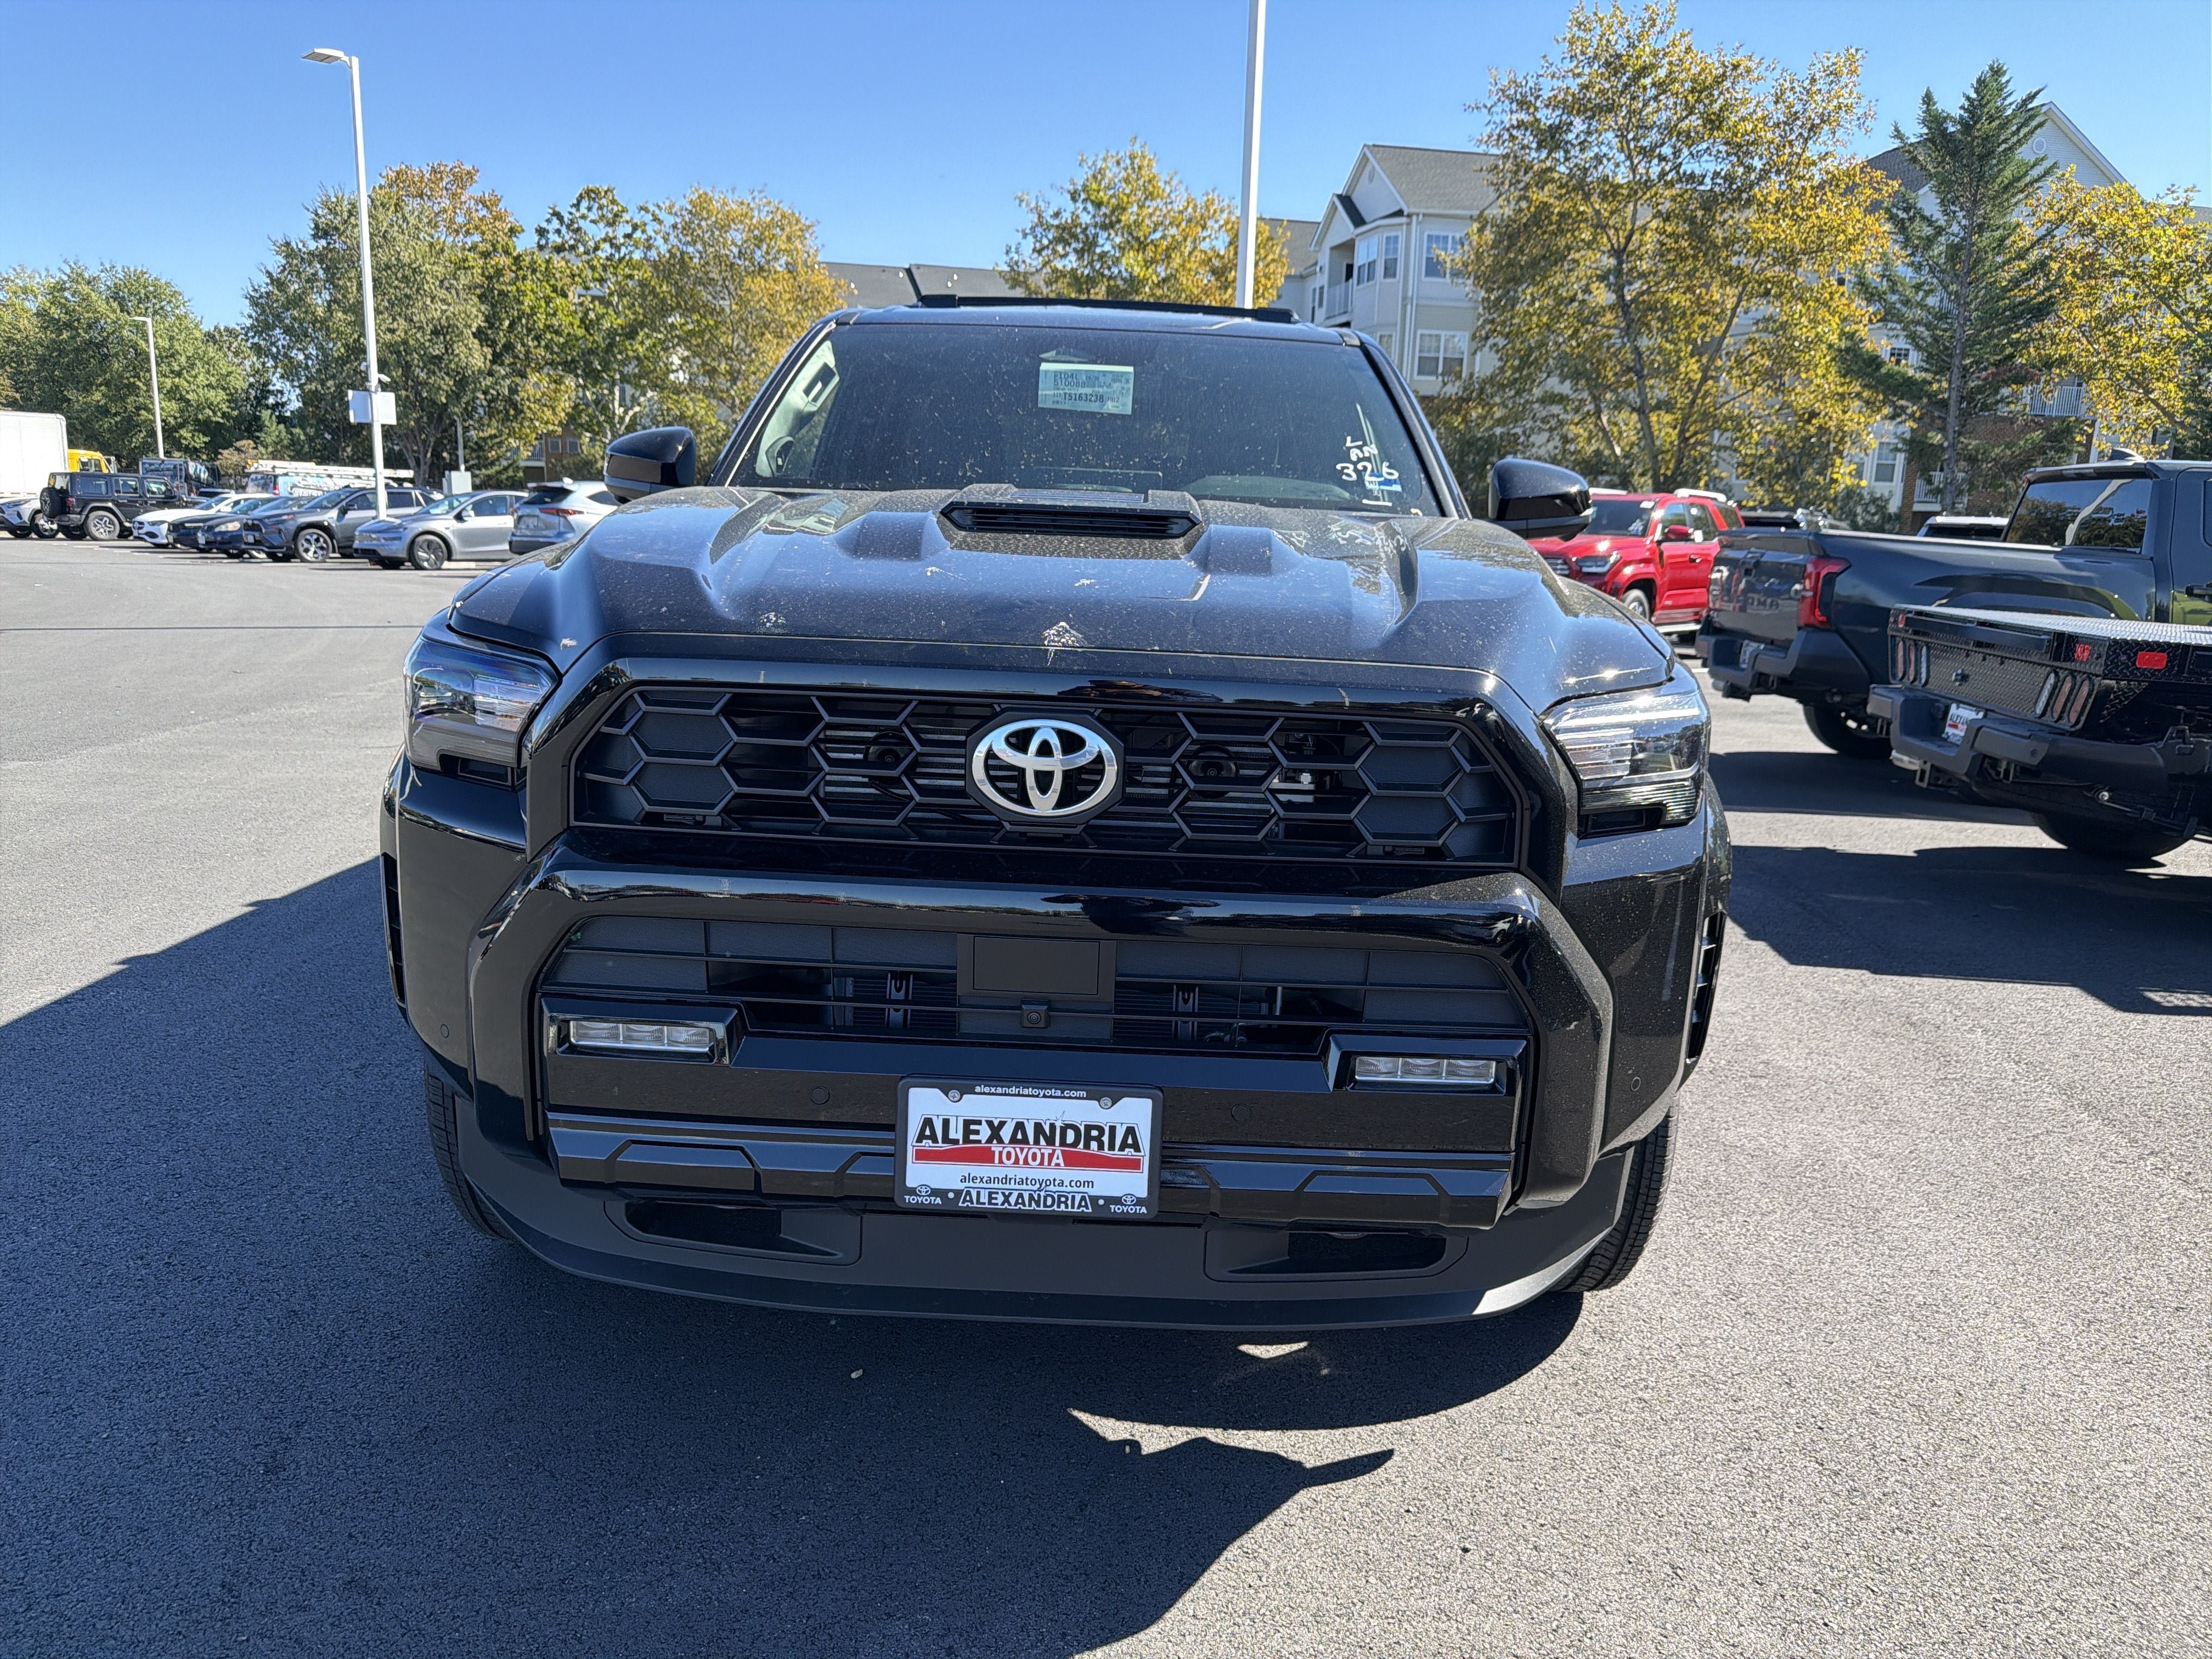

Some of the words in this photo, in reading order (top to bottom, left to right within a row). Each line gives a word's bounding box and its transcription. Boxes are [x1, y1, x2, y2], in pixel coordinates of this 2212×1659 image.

[1063, 392, 1104, 403] T5163238
[1335, 461, 1399, 481] 326
[974, 1085, 1087, 1098] alexandriatoyota.com
[914, 1116, 1143, 1154] ALEXANDRIA
[991, 1146, 1065, 1167] TOYOTA
[960, 1173, 1094, 1189] alexandriatoyota.com
[904, 1195, 942, 1205] TOYOTA
[959, 1187, 1092, 1212] ALEXANDRIA
[1109, 1204, 1147, 1214] TOYOTA
